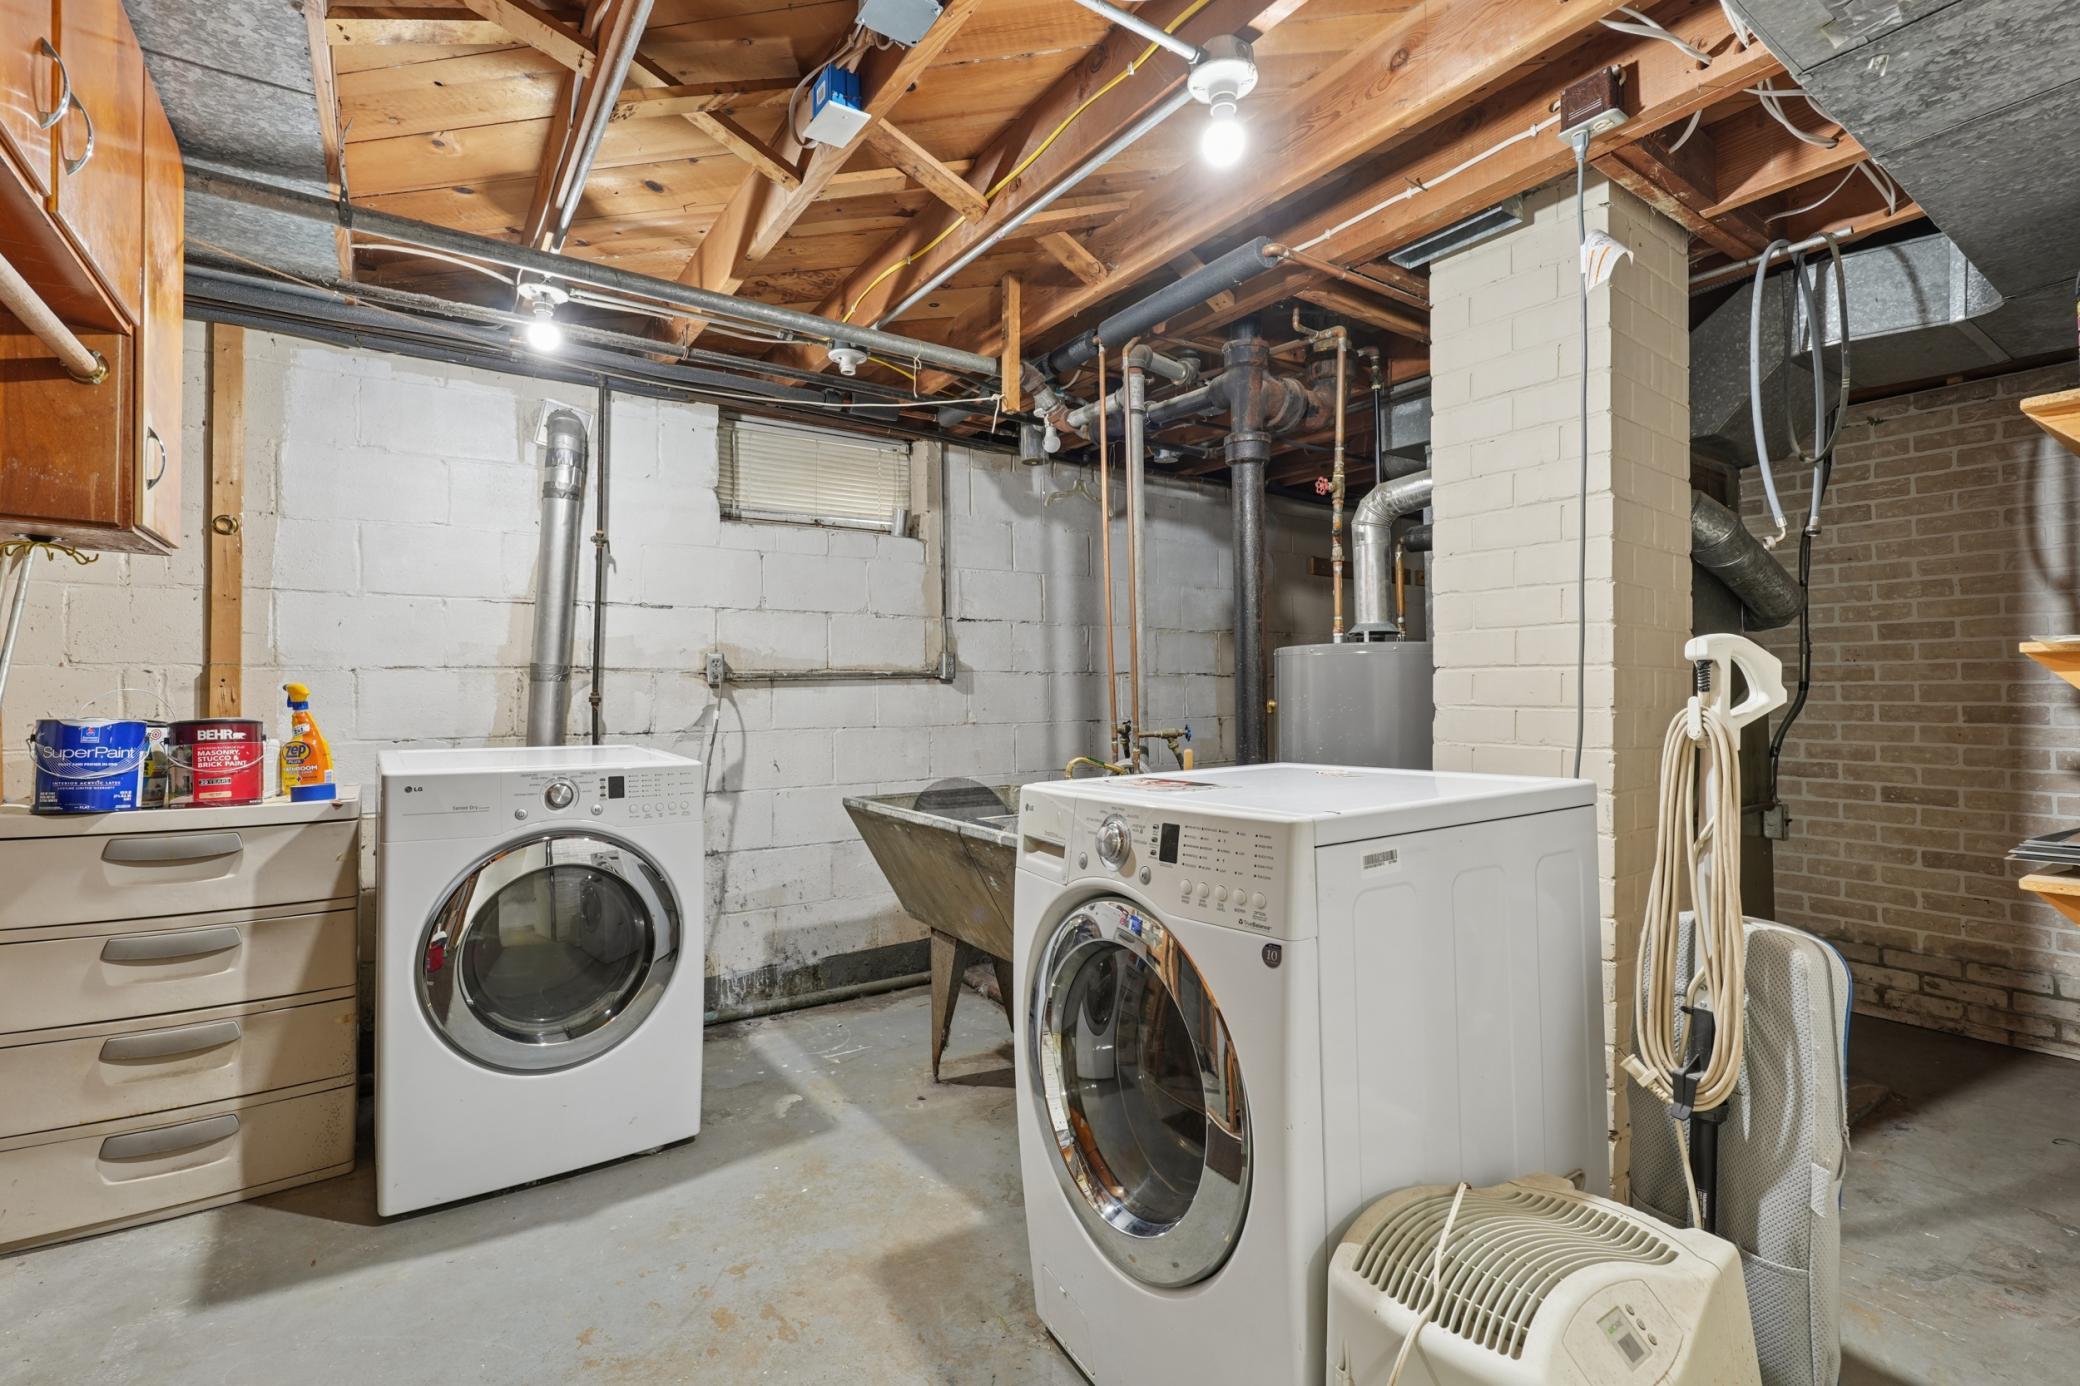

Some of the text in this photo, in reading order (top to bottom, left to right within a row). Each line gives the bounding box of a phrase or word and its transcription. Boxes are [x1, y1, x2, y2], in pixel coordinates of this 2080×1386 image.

[197, 729, 233, 740] BEHR
[43, 746, 135, 760] SuperPaint
[1266, 950, 1278, 961] 10
